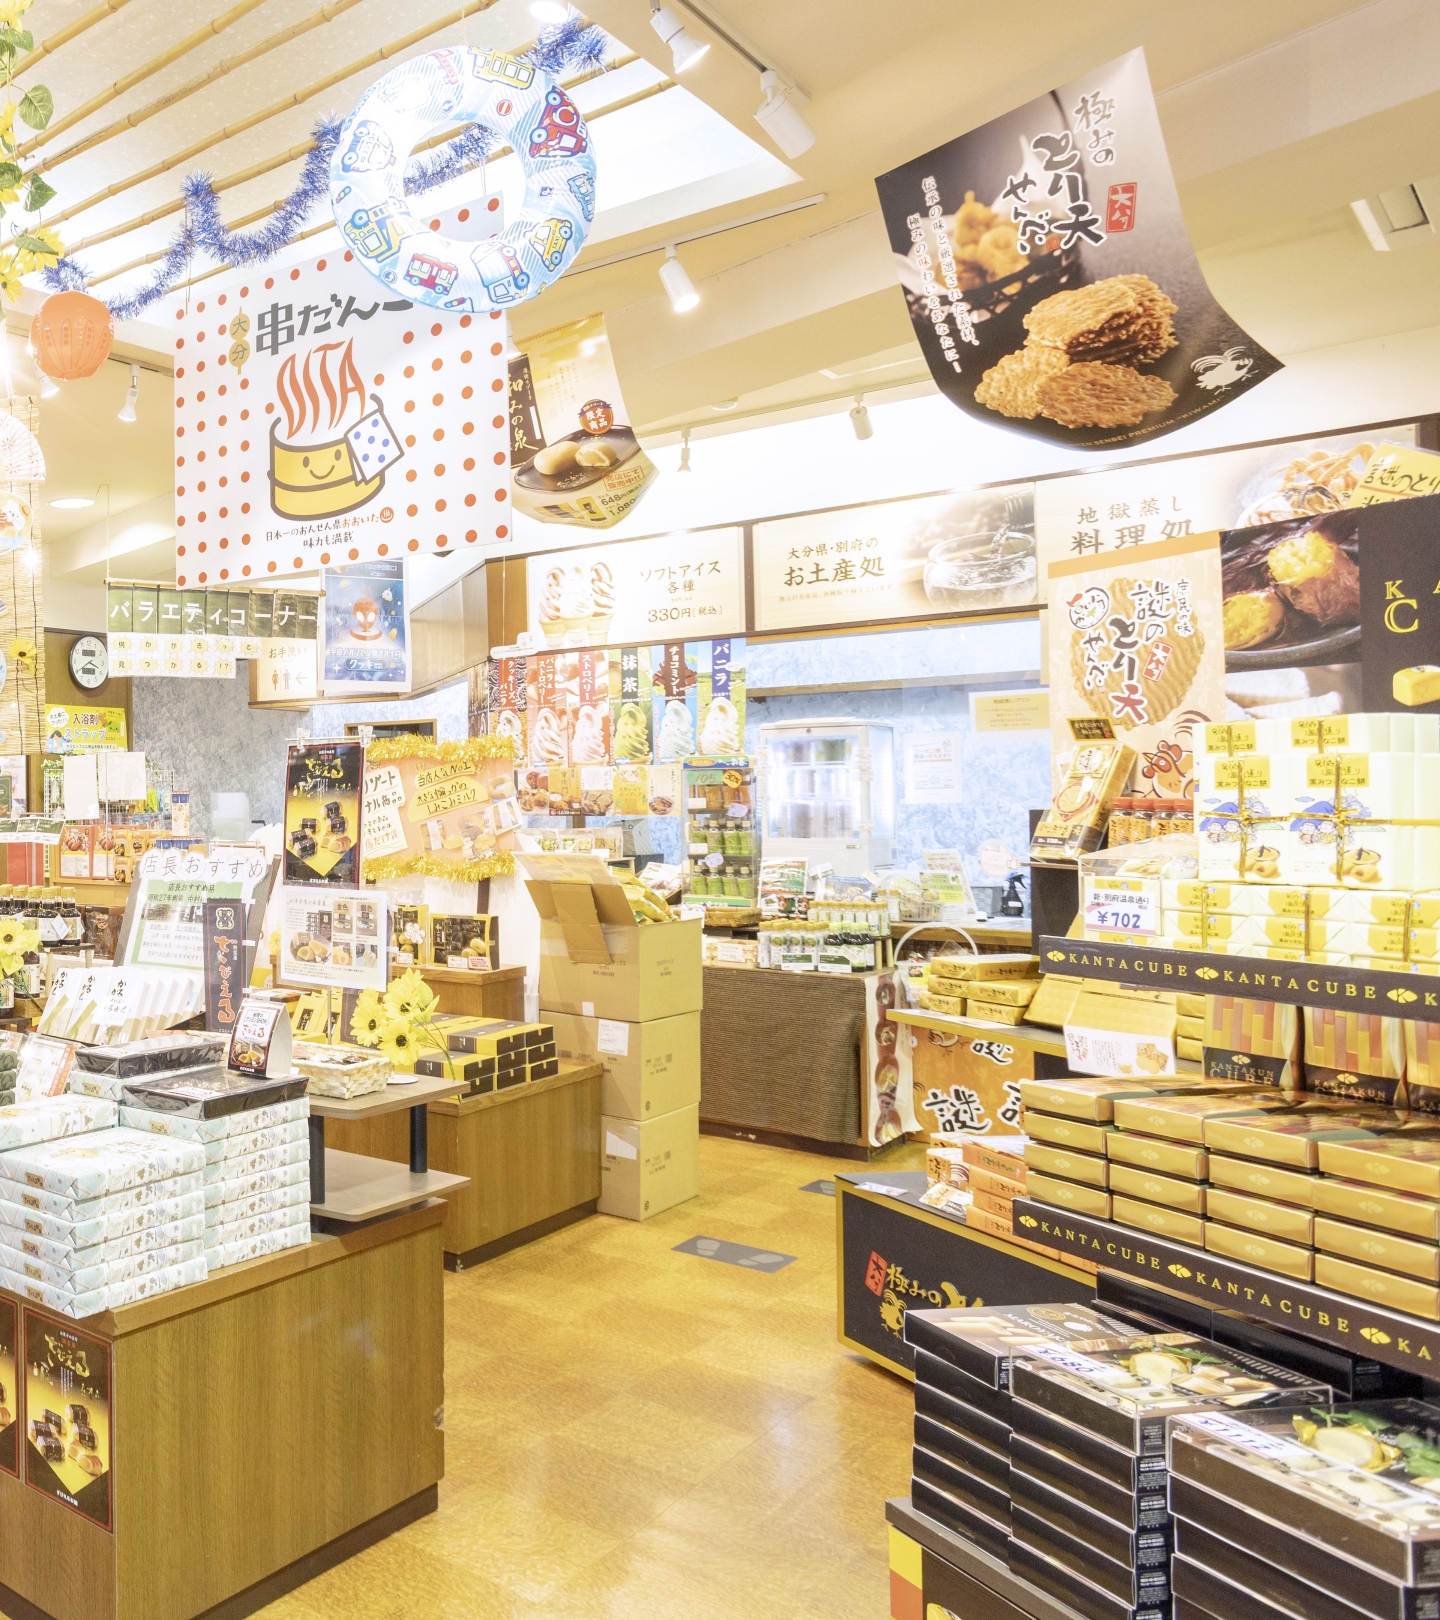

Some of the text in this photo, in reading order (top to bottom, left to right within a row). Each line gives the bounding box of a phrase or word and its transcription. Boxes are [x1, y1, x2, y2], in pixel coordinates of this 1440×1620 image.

[1074, 91, 1116, 165] 極みの
[1033, 133, 1107, 246] とり天
[1109, 186, 1136, 231] 大分
[1002, 174, 1049, 254] せんべい
[552, 235, 560, 250] TAXI
[232, 317, 248, 361] 大分
[256, 293, 414, 356] 串だん
[276, 336, 366, 440] OITA
[586, 408, 606, 420] 限定
[589, 418, 608, 431] 商品
[1128, 419, 1175, 438] PREMIUM
[1077, 495, 1183, 524] 地獄蒸し
[1070, 518, 1194, 555] 料理処
[640, 560, 722, 582] ソフトアイス
[667, 580, 695, 593] 各種
[784, 556, 885, 587] お土産処
[110, 600, 317, 626] バラエティコーナー
[1131, 580, 1171, 642] 謎の
[1175, 579, 1192, 634] 庶民の味
[268, 646, 307, 659] お手洗い
[669, 645, 680, 695] チョコミント
[714, 643, 730, 687] バニラ
[1082, 629, 1108, 688] せんべい
[1109, 618, 1148, 723] とり天
[538, 661, 547, 704] ストロベリー
[582, 655, 593, 701] ストロベリー
[622, 655, 638, 693] 抹茶
[64, 728, 106, 740] ストラップ
[73, 713, 98, 726] 入浴剤
[142, 854, 263, 880] 店長おすすめ
[1097, 910, 1141, 929] ¥702
[214, 935, 238, 1024] ざびえる
[1210, 1061, 1274, 1078] KANTAKUN
[1314, 1079, 1386, 1099] KANTAKUN
[886, 1264, 943, 1308] 極みの
